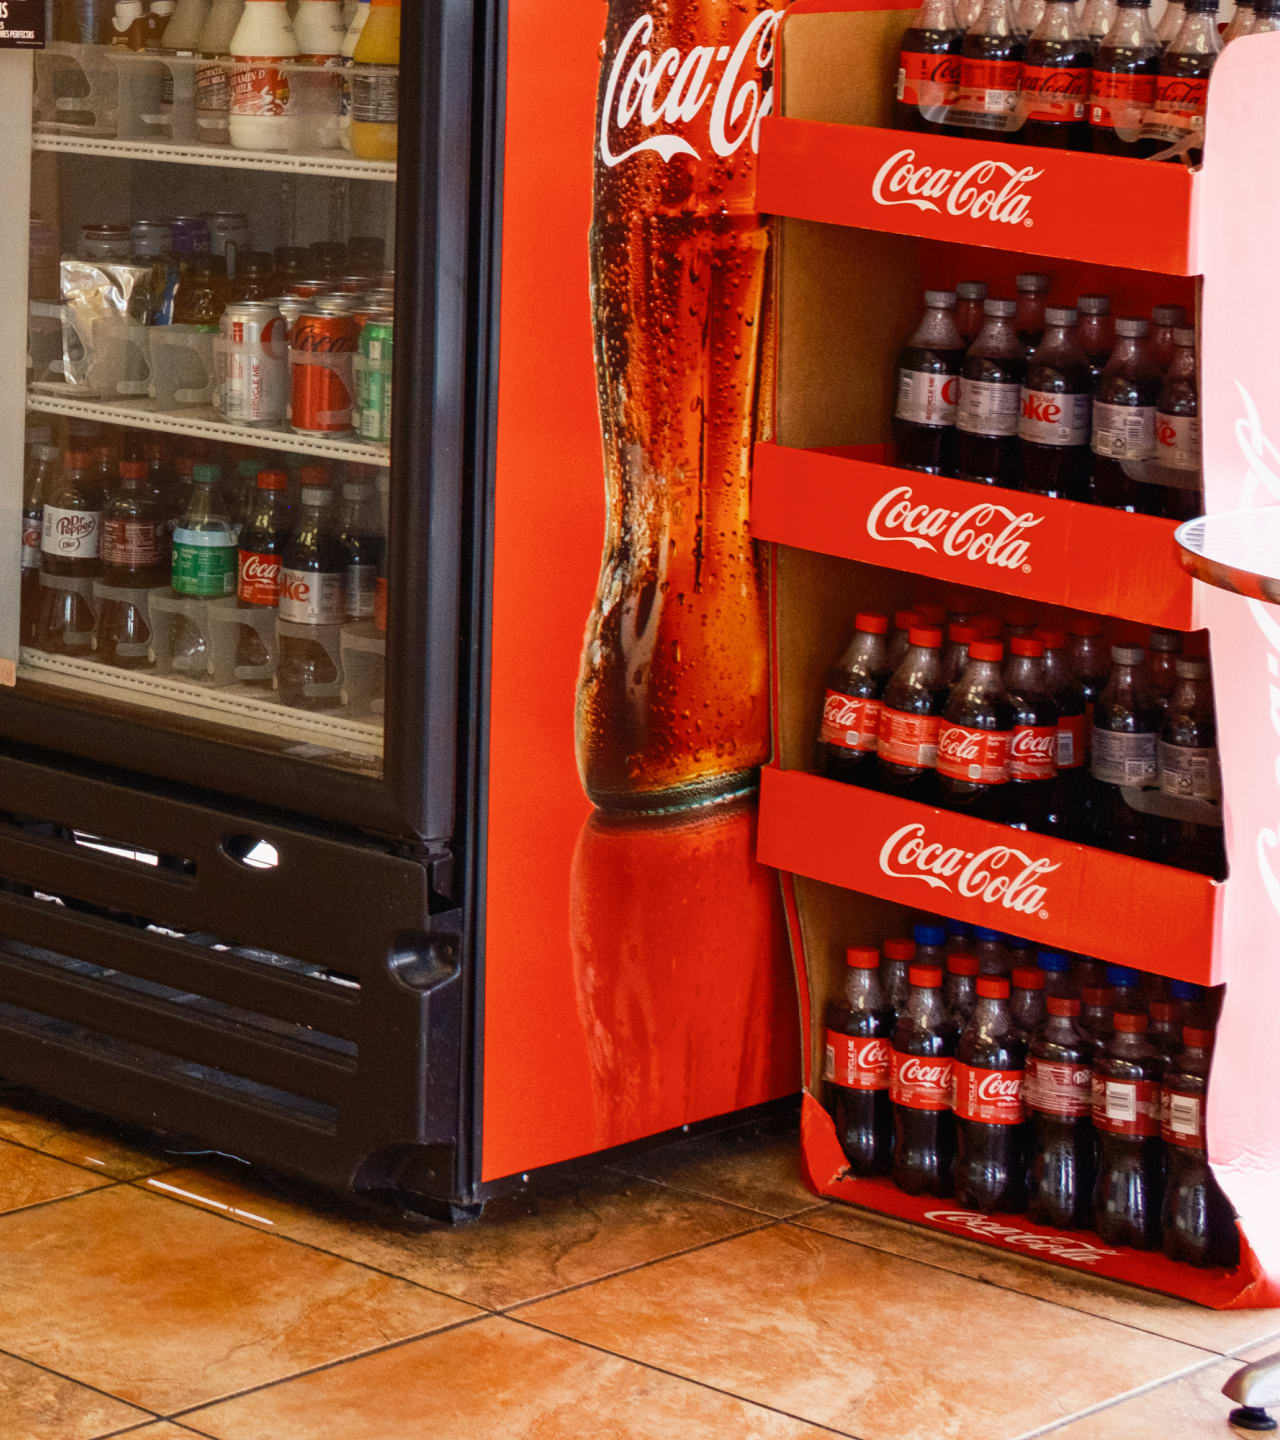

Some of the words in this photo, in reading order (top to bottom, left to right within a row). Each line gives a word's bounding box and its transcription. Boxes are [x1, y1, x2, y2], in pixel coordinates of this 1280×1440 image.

[600, 10, 785, 167] Coca-C
[872, 149, 1046, 225] Coca-Cola
[252, 364, 260, 378] ME
[929, 376, 936, 390] ME
[252, 379, 260, 418] RECYCLE
[925, 391, 935, 420] RECYCLE
[56, 516, 95, 537] Pepper
[70, 515, 85, 526] Dr
[866, 486, 1045, 570] Coca-Cola
[61, 540, 76, 550] Diet
[280, 578, 311, 602] ke
[879, 823, 1063, 914] Coca-Cola
[847, 1039, 855, 1052] ME
[847, 1056, 855, 1084] RECYCLE
[969, 1071, 976, 1083] ME
[968, 1087, 976, 1116] RECYCLE
[923, 1211, 1129, 1262] Coca-Cola
